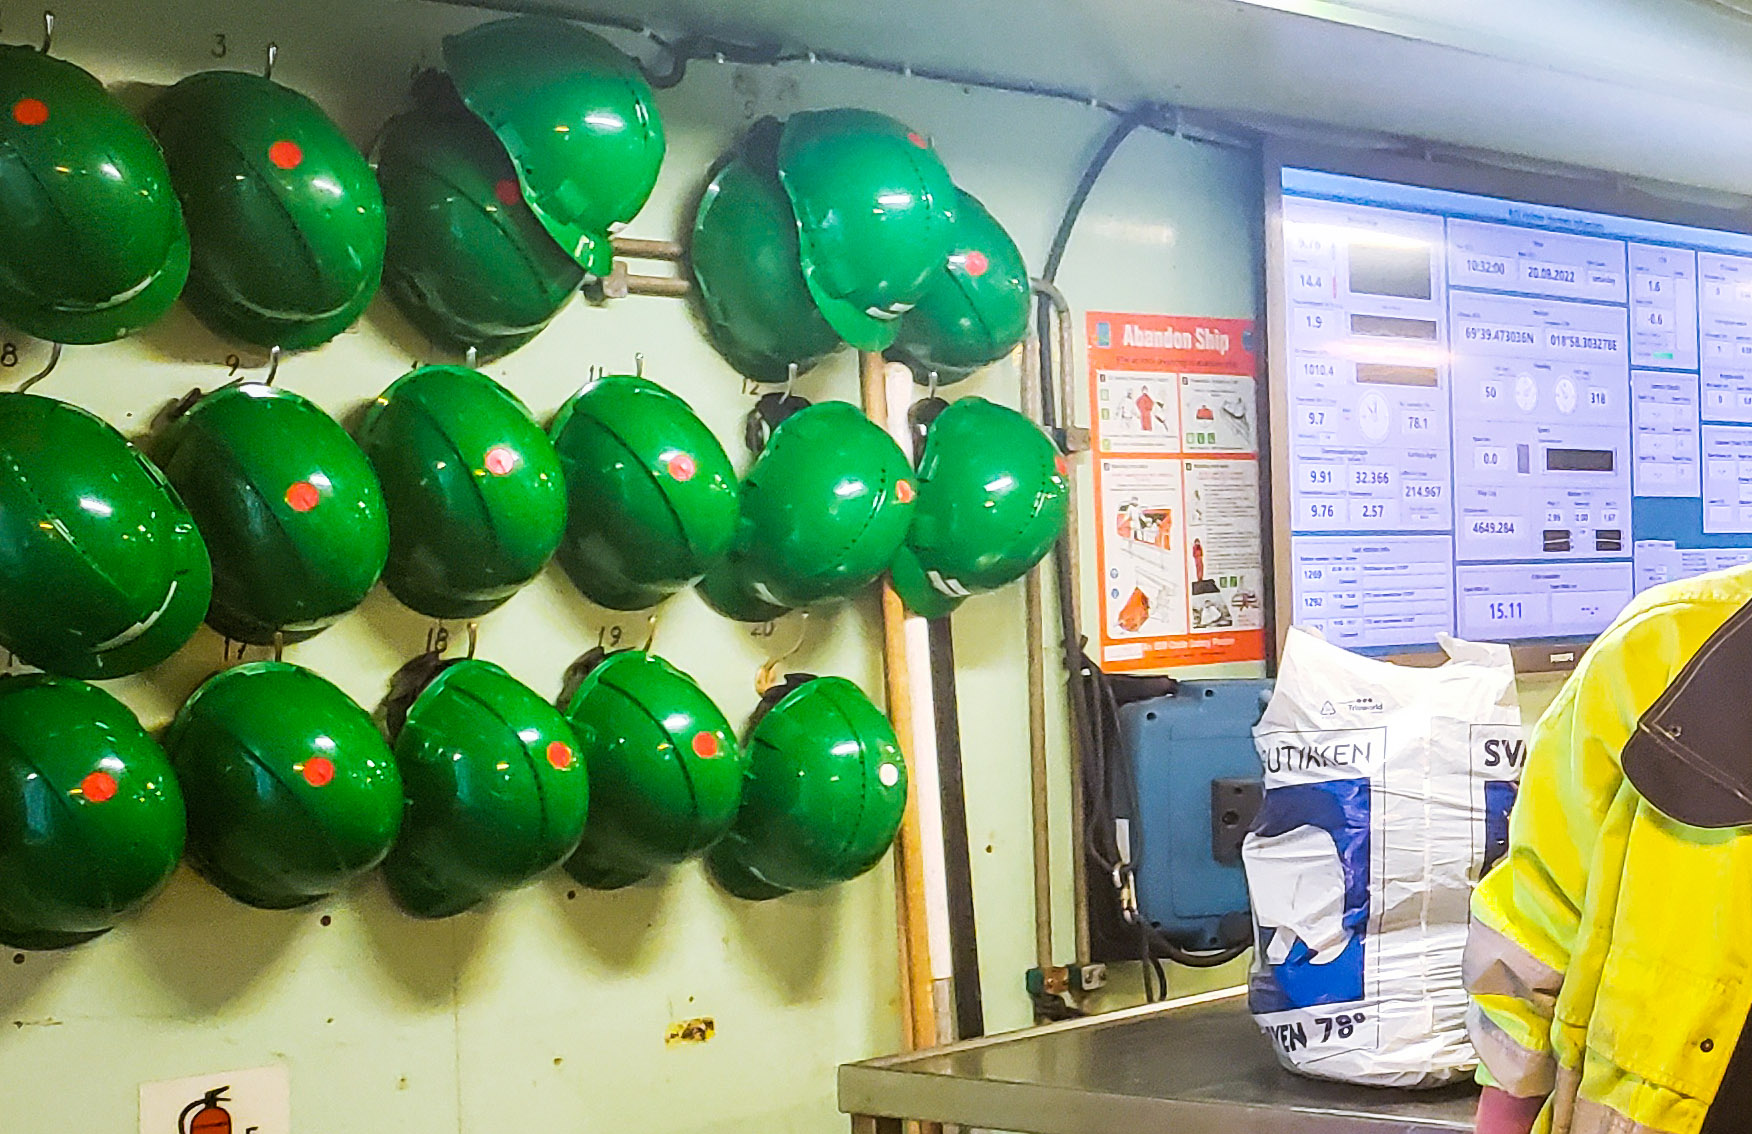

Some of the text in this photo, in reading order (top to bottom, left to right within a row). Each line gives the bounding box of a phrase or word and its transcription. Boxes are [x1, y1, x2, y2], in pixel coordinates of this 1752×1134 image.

[212, 34, 227, 58] 3
[1306, 315, 1322, 328] 1.9
[1123, 323, 1230, 356] Abandon Ship
[0, 342, 18, 367] 8
[226, 354, 239, 376] 9
[1304, 364, 1334, 376] 1010.4
[1308, 412, 1325, 425] 9.7
[1408, 416, 1428, 430] 78.1
[1483, 452, 1498, 465] 0.0
[1310, 470, 1332, 484] 9.91
[1355, 471, 1389, 484] 32.366
[1311, 504, 1334, 518] 9.76
[1362, 504, 1384, 518] 2.57
[1472, 522, 1515, 535] 4649.284
[1489, 602, 1523, 620] 15.11
[426, 627, 448, 653] 18
[598, 626, 622, 649] 19
[1262, 741, 1372, 774] UTIKKEN
